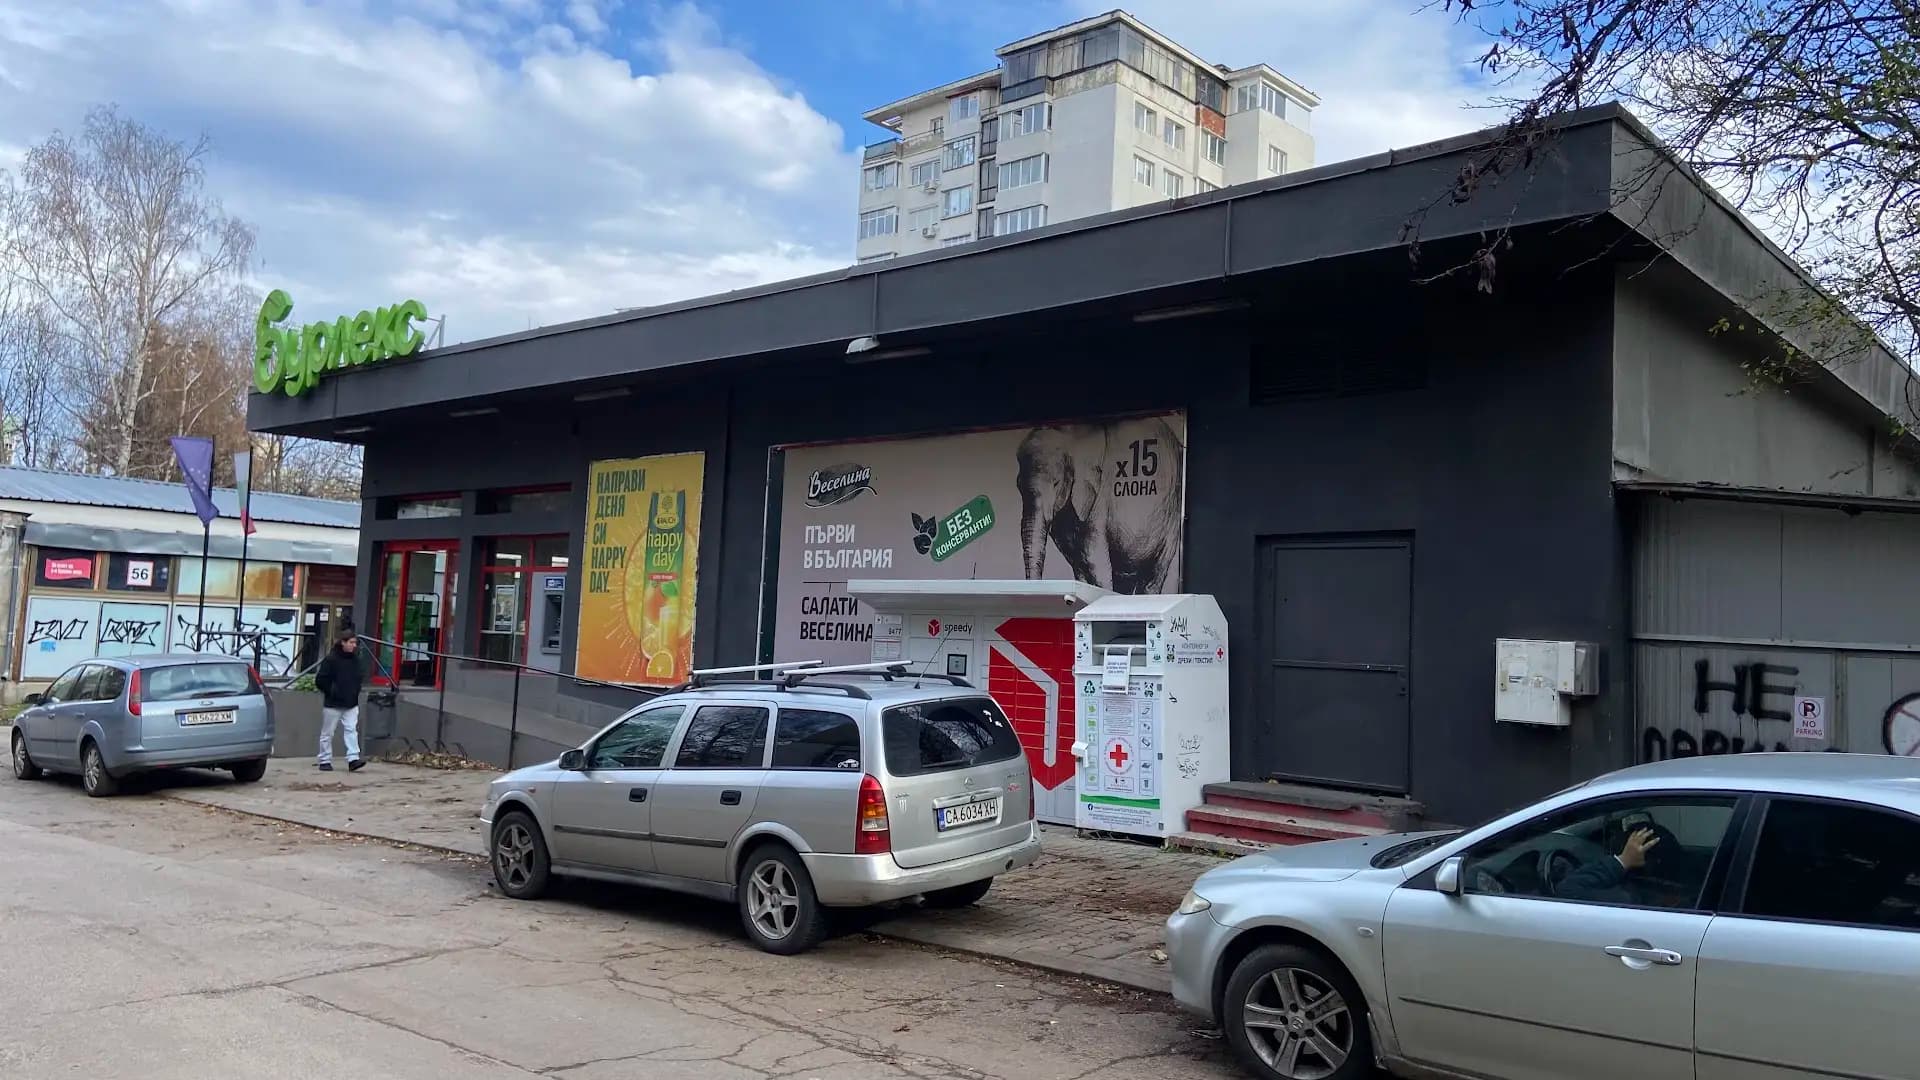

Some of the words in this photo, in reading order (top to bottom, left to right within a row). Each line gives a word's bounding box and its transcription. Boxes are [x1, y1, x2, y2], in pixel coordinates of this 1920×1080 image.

[597, 469, 646, 494] НАПРАВИ
[808, 466, 871, 499] Веселина
[1114, 479, 1157, 497] СЛОНА
[595, 495, 626, 520] ДЕНЯ
[593, 522, 607, 545] СИ
[946, 508, 973, 537] БЕЗ
[648, 529, 683, 552] happy
[804, 524, 856, 545] ПЪРВИ
[935, 513, 993, 558] КОНСЕРВАНТИ!
[591, 546, 627, 569] HAPPY
[653, 550, 676, 571] day
[803, 549, 814, 569] В
[814, 548, 893, 570] БЪЛГАРИЯ
[131, 567, 149, 581] 56
[589, 571, 610, 593] DAY.
[801, 596, 858, 617] САЛАТИ
[799, 621, 873, 643] ВЕСЕЛИНА
[944, 623, 973, 635] speedy
[1694, 659, 1799, 723] НЕ
[1795, 728, 1823, 736] PARKING
[1802, 720, 1816, 728] NO
[945, 810, 960, 825] CA
[960, 803, 983, 821] 6034
[984, 800, 996, 816] XH
